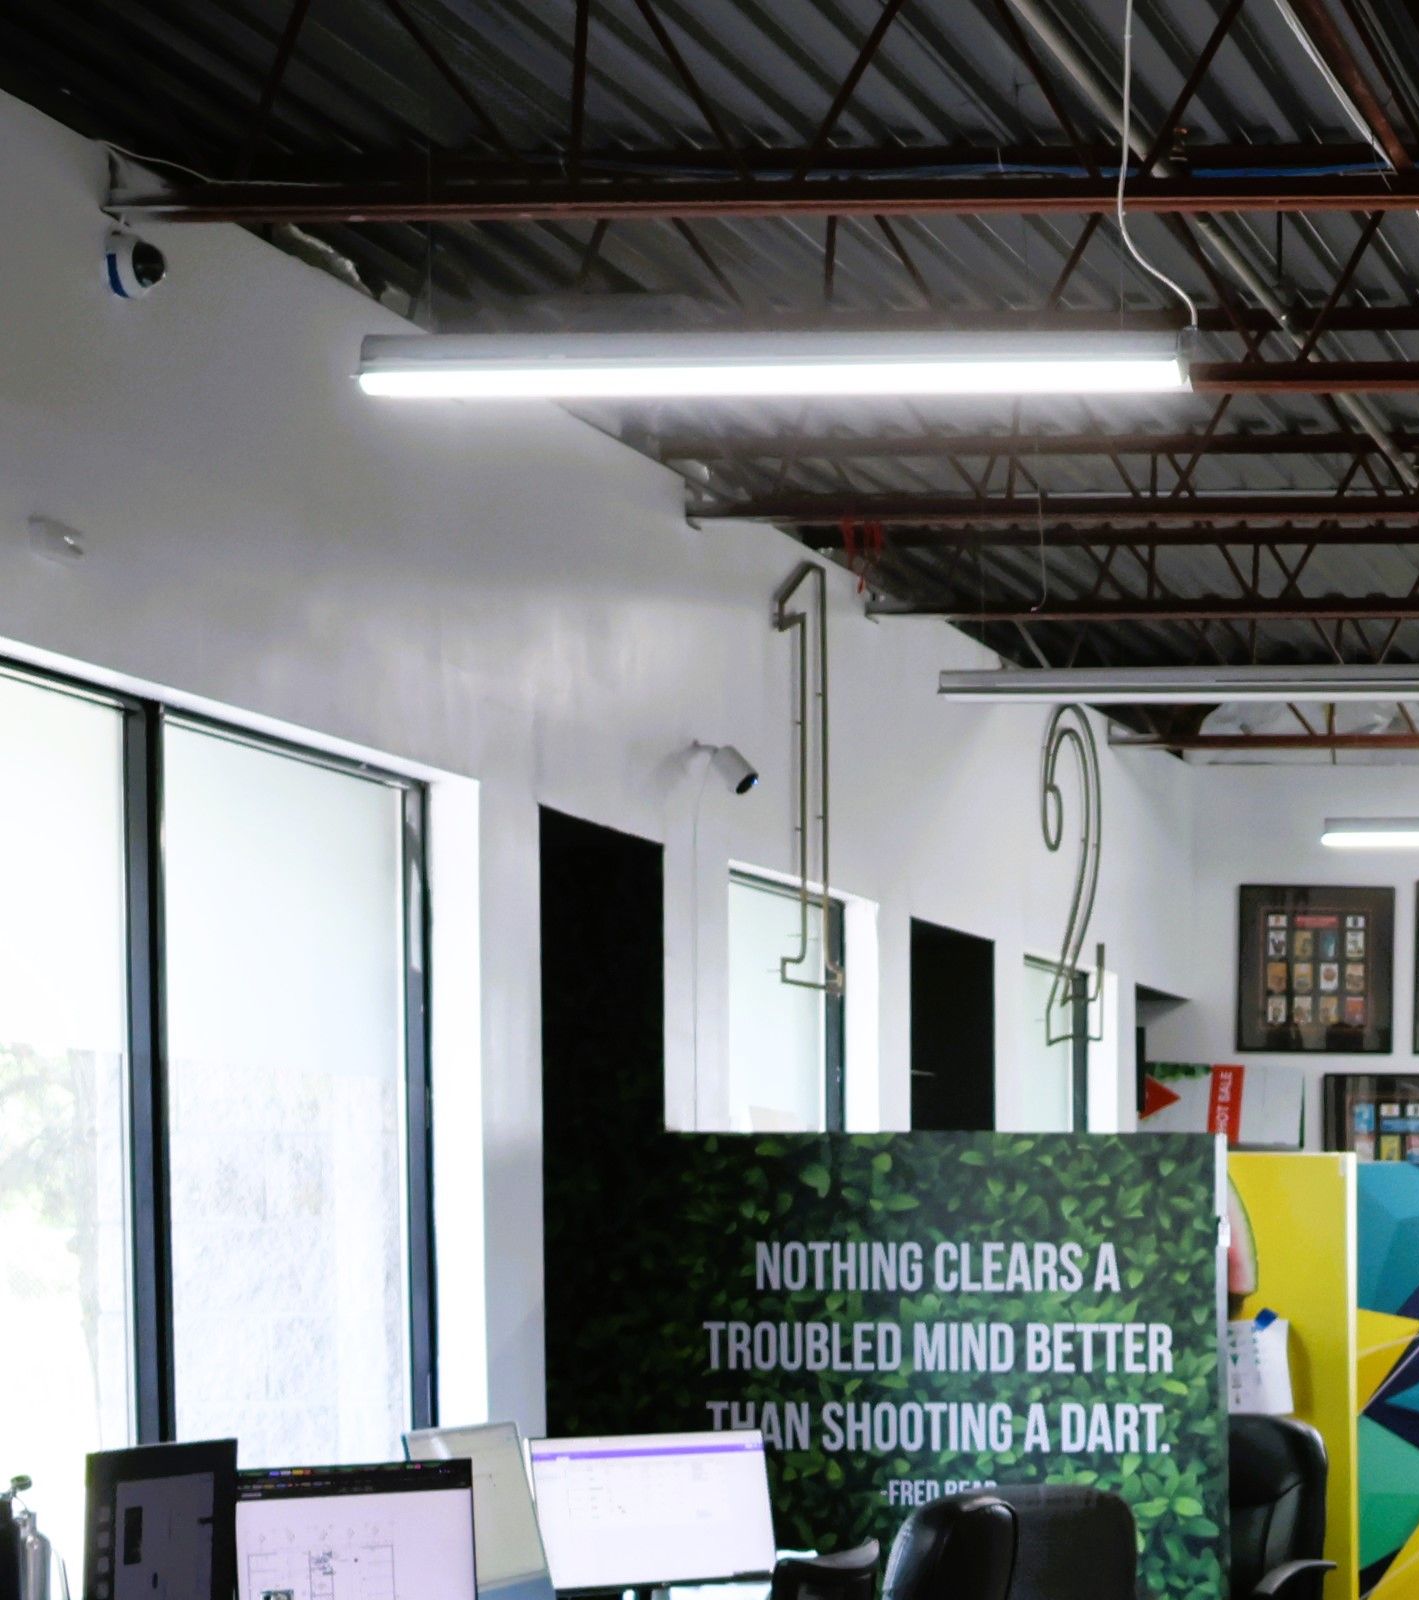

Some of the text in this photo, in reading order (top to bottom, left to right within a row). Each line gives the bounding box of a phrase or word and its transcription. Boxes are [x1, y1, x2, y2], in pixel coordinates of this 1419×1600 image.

[755, 1241, 1120, 1293] NOTHING CLEARS A
[702, 1321, 1173, 1374] TROUBLED MIND BETTER
[822, 1402, 1013, 1452] SHOOTING
[1024, 1402, 1050, 1453] A
[1061, 1403, 1171, 1453] DART.
